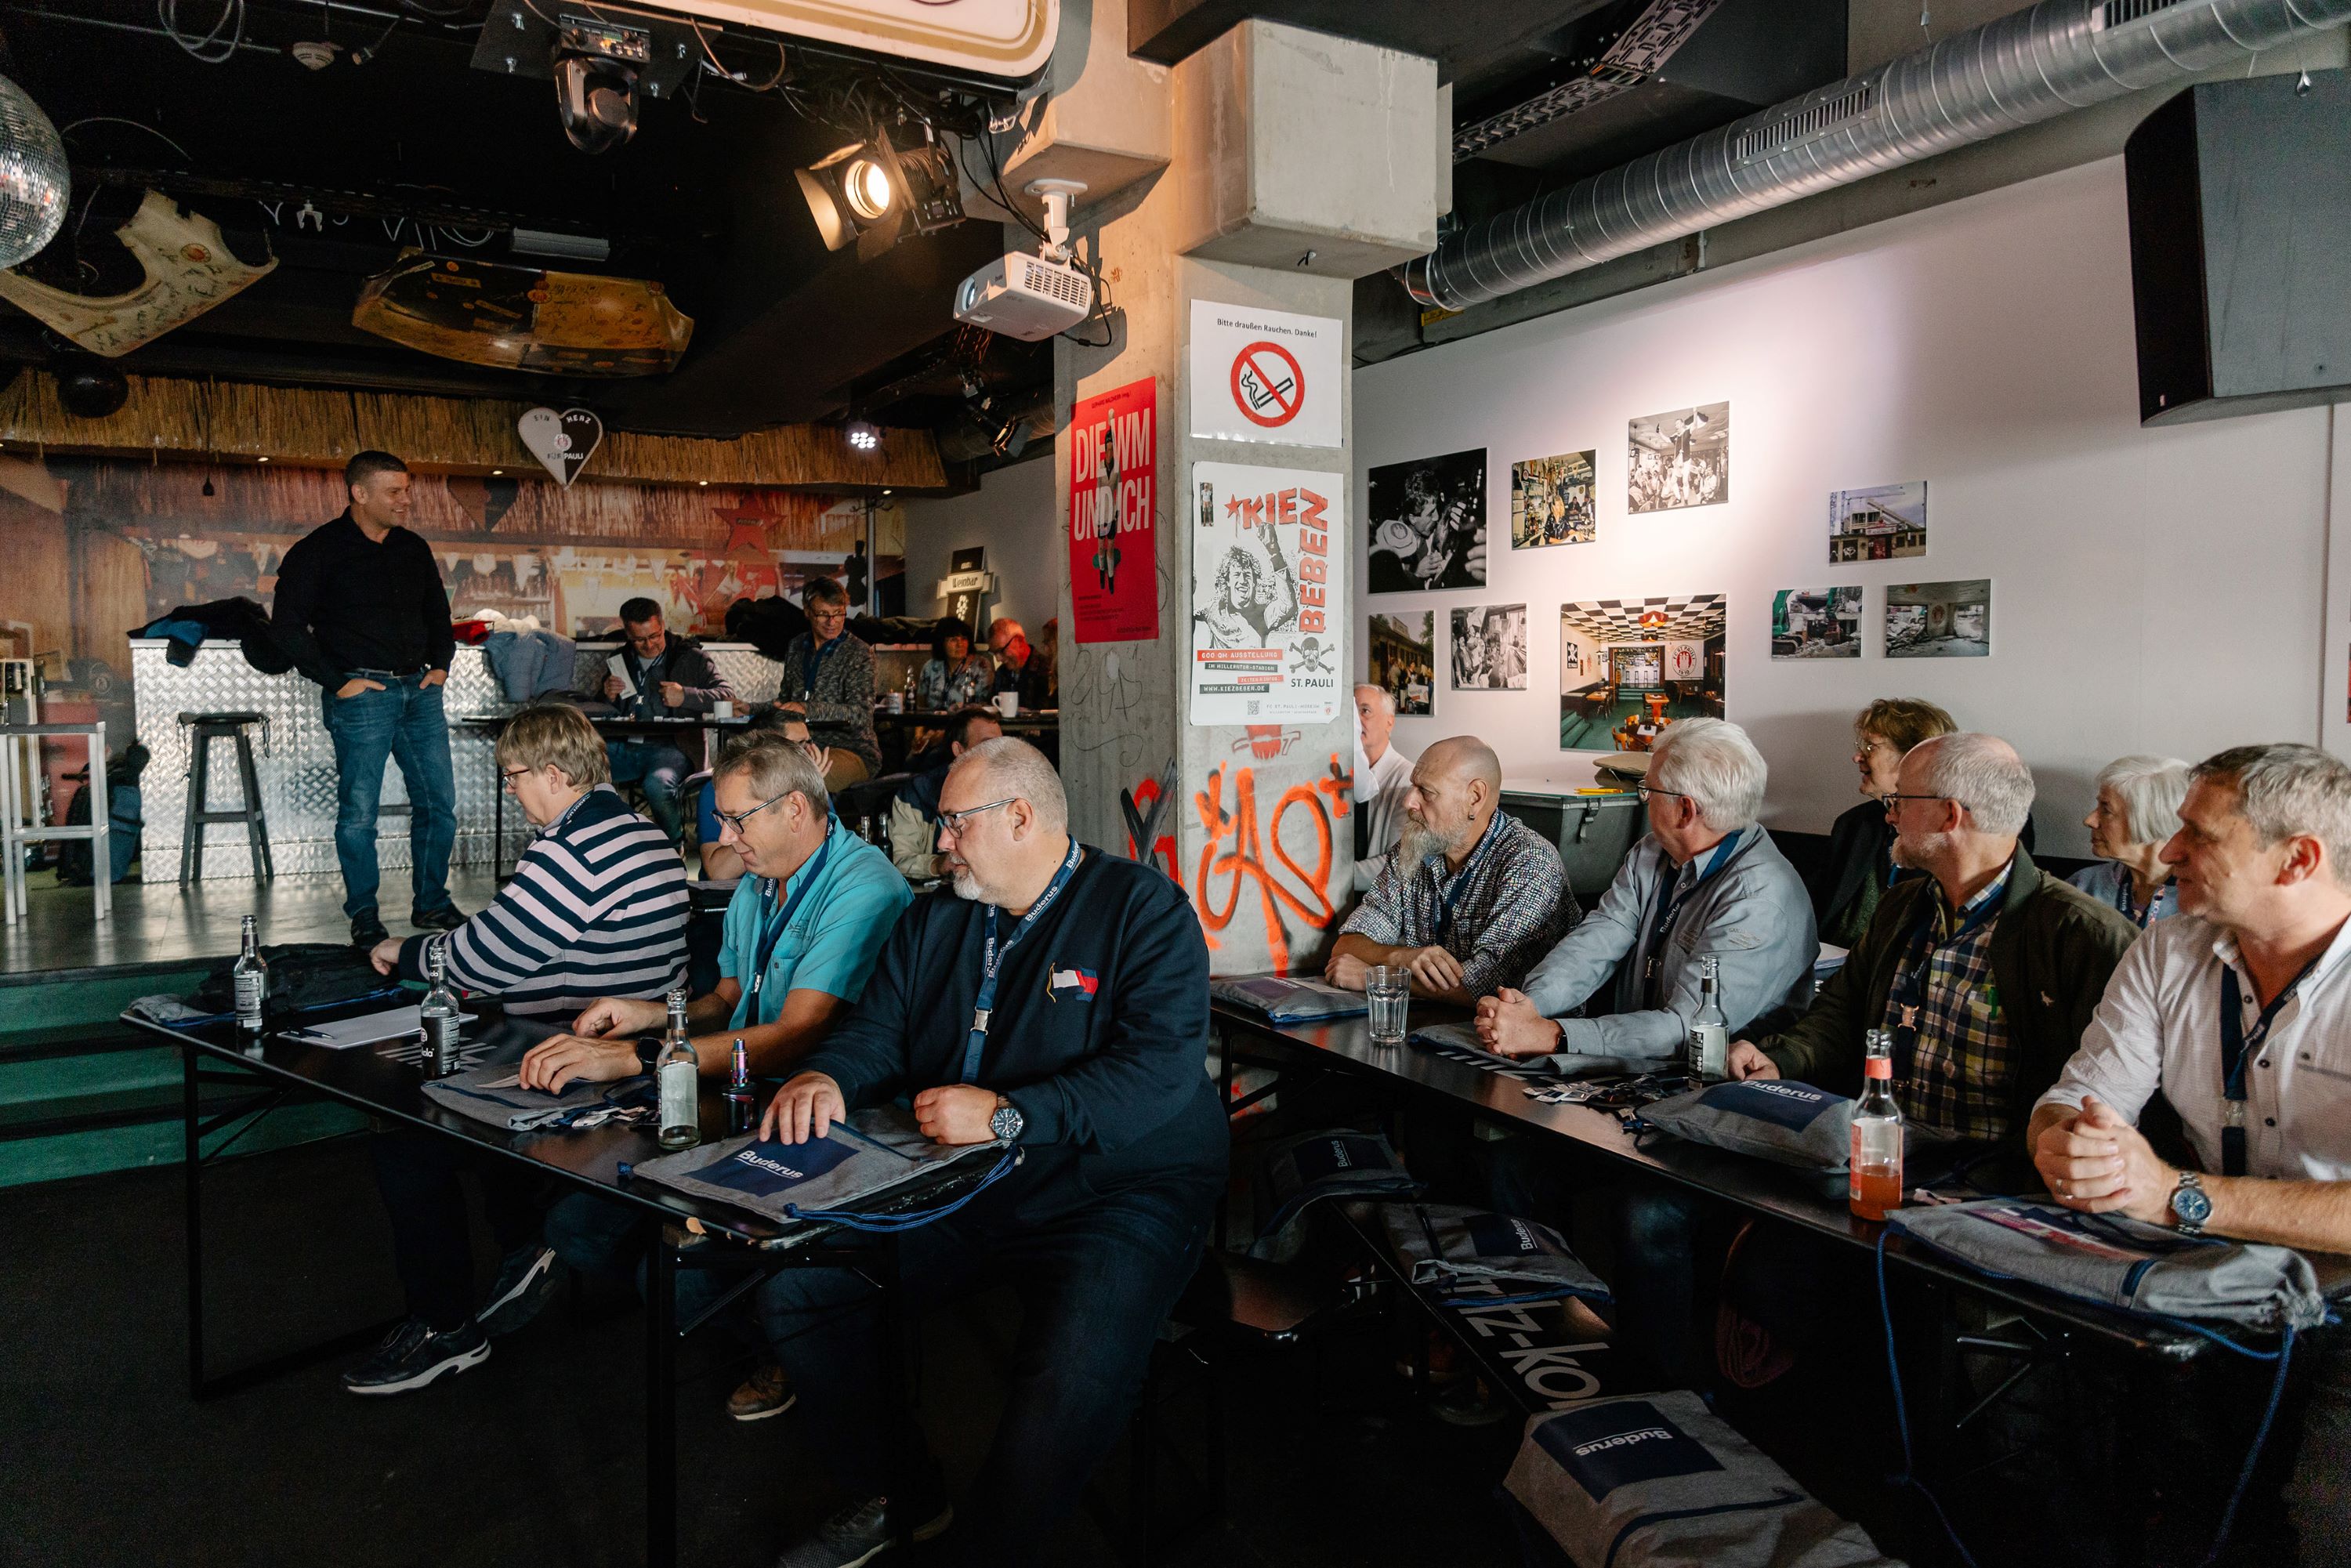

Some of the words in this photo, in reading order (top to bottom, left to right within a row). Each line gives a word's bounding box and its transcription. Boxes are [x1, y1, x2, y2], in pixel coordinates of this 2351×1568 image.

[1217, 318, 1233, 328] Bitte
[1234, 320, 1262, 331] draußen
[1263, 324, 1293, 335] Rauchen.
[1295, 328, 1317, 339] Danke!
[566, 415, 592, 424] HERZ
[1076, 421, 1107, 483] DIE
[1110, 407, 1150, 473] WM
[1074, 485, 1114, 541] UND
[1118, 476, 1150, 534] ICH
[952, 577, 978, 588] Weinbar
[1291, 679, 1303, 687] ST.
[1305, 679, 1334, 687] PAULI
[1025, 885, 1059, 922] Buderus
[1740, 1080, 1823, 1101] Buderus
[737, 1150, 804, 1179] Buderus
[1331, 1140, 1349, 1168] Buderus
[1511, 1219, 1534, 1251] Buderus
[1575, 1431, 1674, 1456] Buderus
